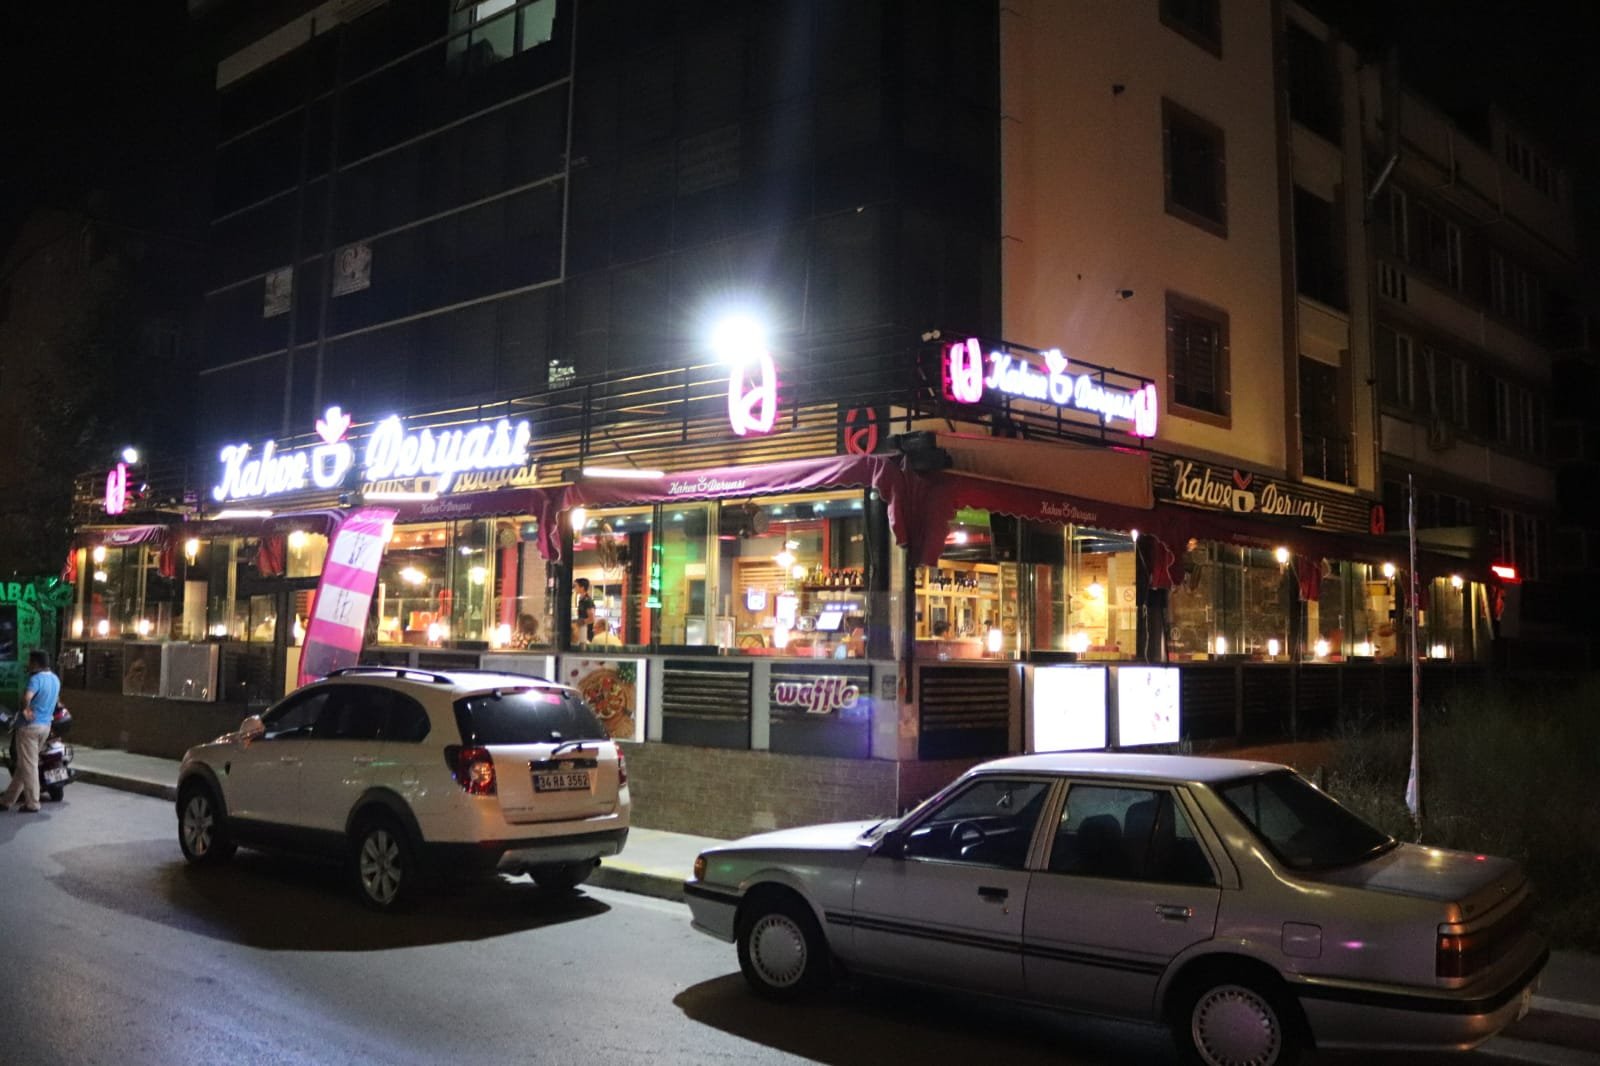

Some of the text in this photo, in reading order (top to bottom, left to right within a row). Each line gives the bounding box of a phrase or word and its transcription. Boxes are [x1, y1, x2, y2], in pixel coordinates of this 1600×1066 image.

[1173, 459, 1233, 507] Kahve
[774, 675, 859, 714] waffle
[539, 775, 552, 788] 34
